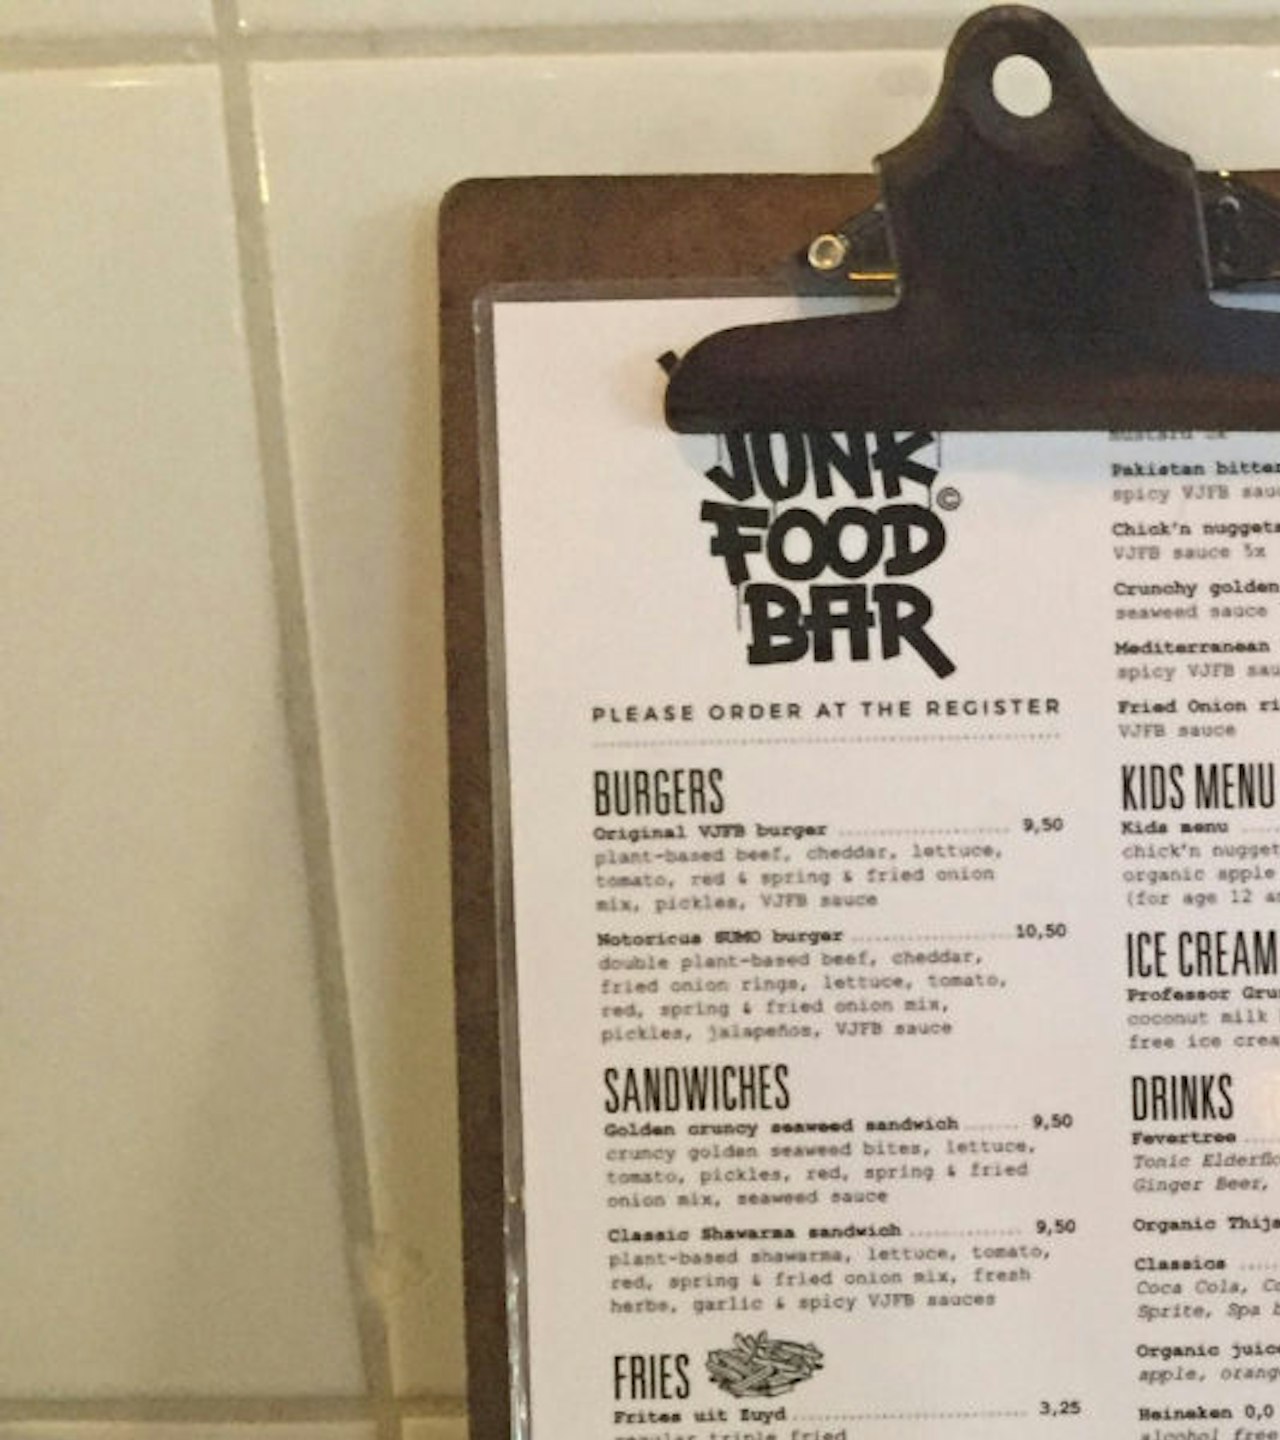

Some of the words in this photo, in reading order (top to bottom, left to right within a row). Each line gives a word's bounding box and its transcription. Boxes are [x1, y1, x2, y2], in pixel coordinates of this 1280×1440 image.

[705, 431, 940, 501] JUNK
[1111, 462, 1206, 477] Pakistan
[1111, 521, 1192, 536] Chick'n
[701, 500, 946, 585] FOOD
[1113, 581, 1198, 598] Crunchy
[1209, 579, 1280, 598] golden
[744, 583, 956, 679] BAR
[1114, 641, 1270, 655] Mediterranean
[592, 705, 693, 723] PLEASE
[708, 702, 802, 721] ORDER
[815, 701, 846, 719] AT
[860, 700, 911, 717] THE
[926, 698, 1060, 716] REGISTER
[1117, 699, 1178, 714] Fried
[1187, 699, 1247, 713] Onion
[593, 768, 725, 816] BURGERS
[1121, 764, 1185, 811] KIDS
[1195, 763, 1275, 809] MENU
[592, 825, 687, 843] Original
[698, 823, 747, 839] VJFB
[755, 823, 828, 840] burger
[1022, 817, 1064, 834] 9,50
[1121, 820, 1168, 835] Kids
[1180, 822, 1229, 834] menu
[714, 930, 762, 945] SUMO
[1016, 923, 1067, 940] 10,50
[1126, 931, 1168, 978] ICE
[1178, 930, 1277, 977] CREAM
[604, 1065, 790, 1113] SANDWICHES
[1132, 1075, 1234, 1121] DRINKS
[604, 1122, 676, 1137] Golden
[770, 1119, 854, 1134] seaweed
[866, 1117, 959, 1132] sandwich
[1032, 1113, 1073, 1131] 9,50
[1131, 1131, 1237, 1145] Fevertree
[607, 1228, 689, 1243] Classic
[700, 1227, 796, 1241] Shawarma
[808, 1224, 902, 1239] sandwich
[1036, 1218, 1076, 1236] 9,50
[1133, 1218, 1216, 1235] Organic
[1134, 1257, 1227, 1272] Classics
[1136, 1344, 1220, 1361] Organic
[614, 1354, 690, 1400] FRIES
[614, 1410, 682, 1424] Frites
[693, 1409, 728, 1423] uit
[1039, 1400, 1082, 1417] 3,25
[1138, 1407, 1233, 1421] Heineken
[1244, 1404, 1274, 1421] 0,0
